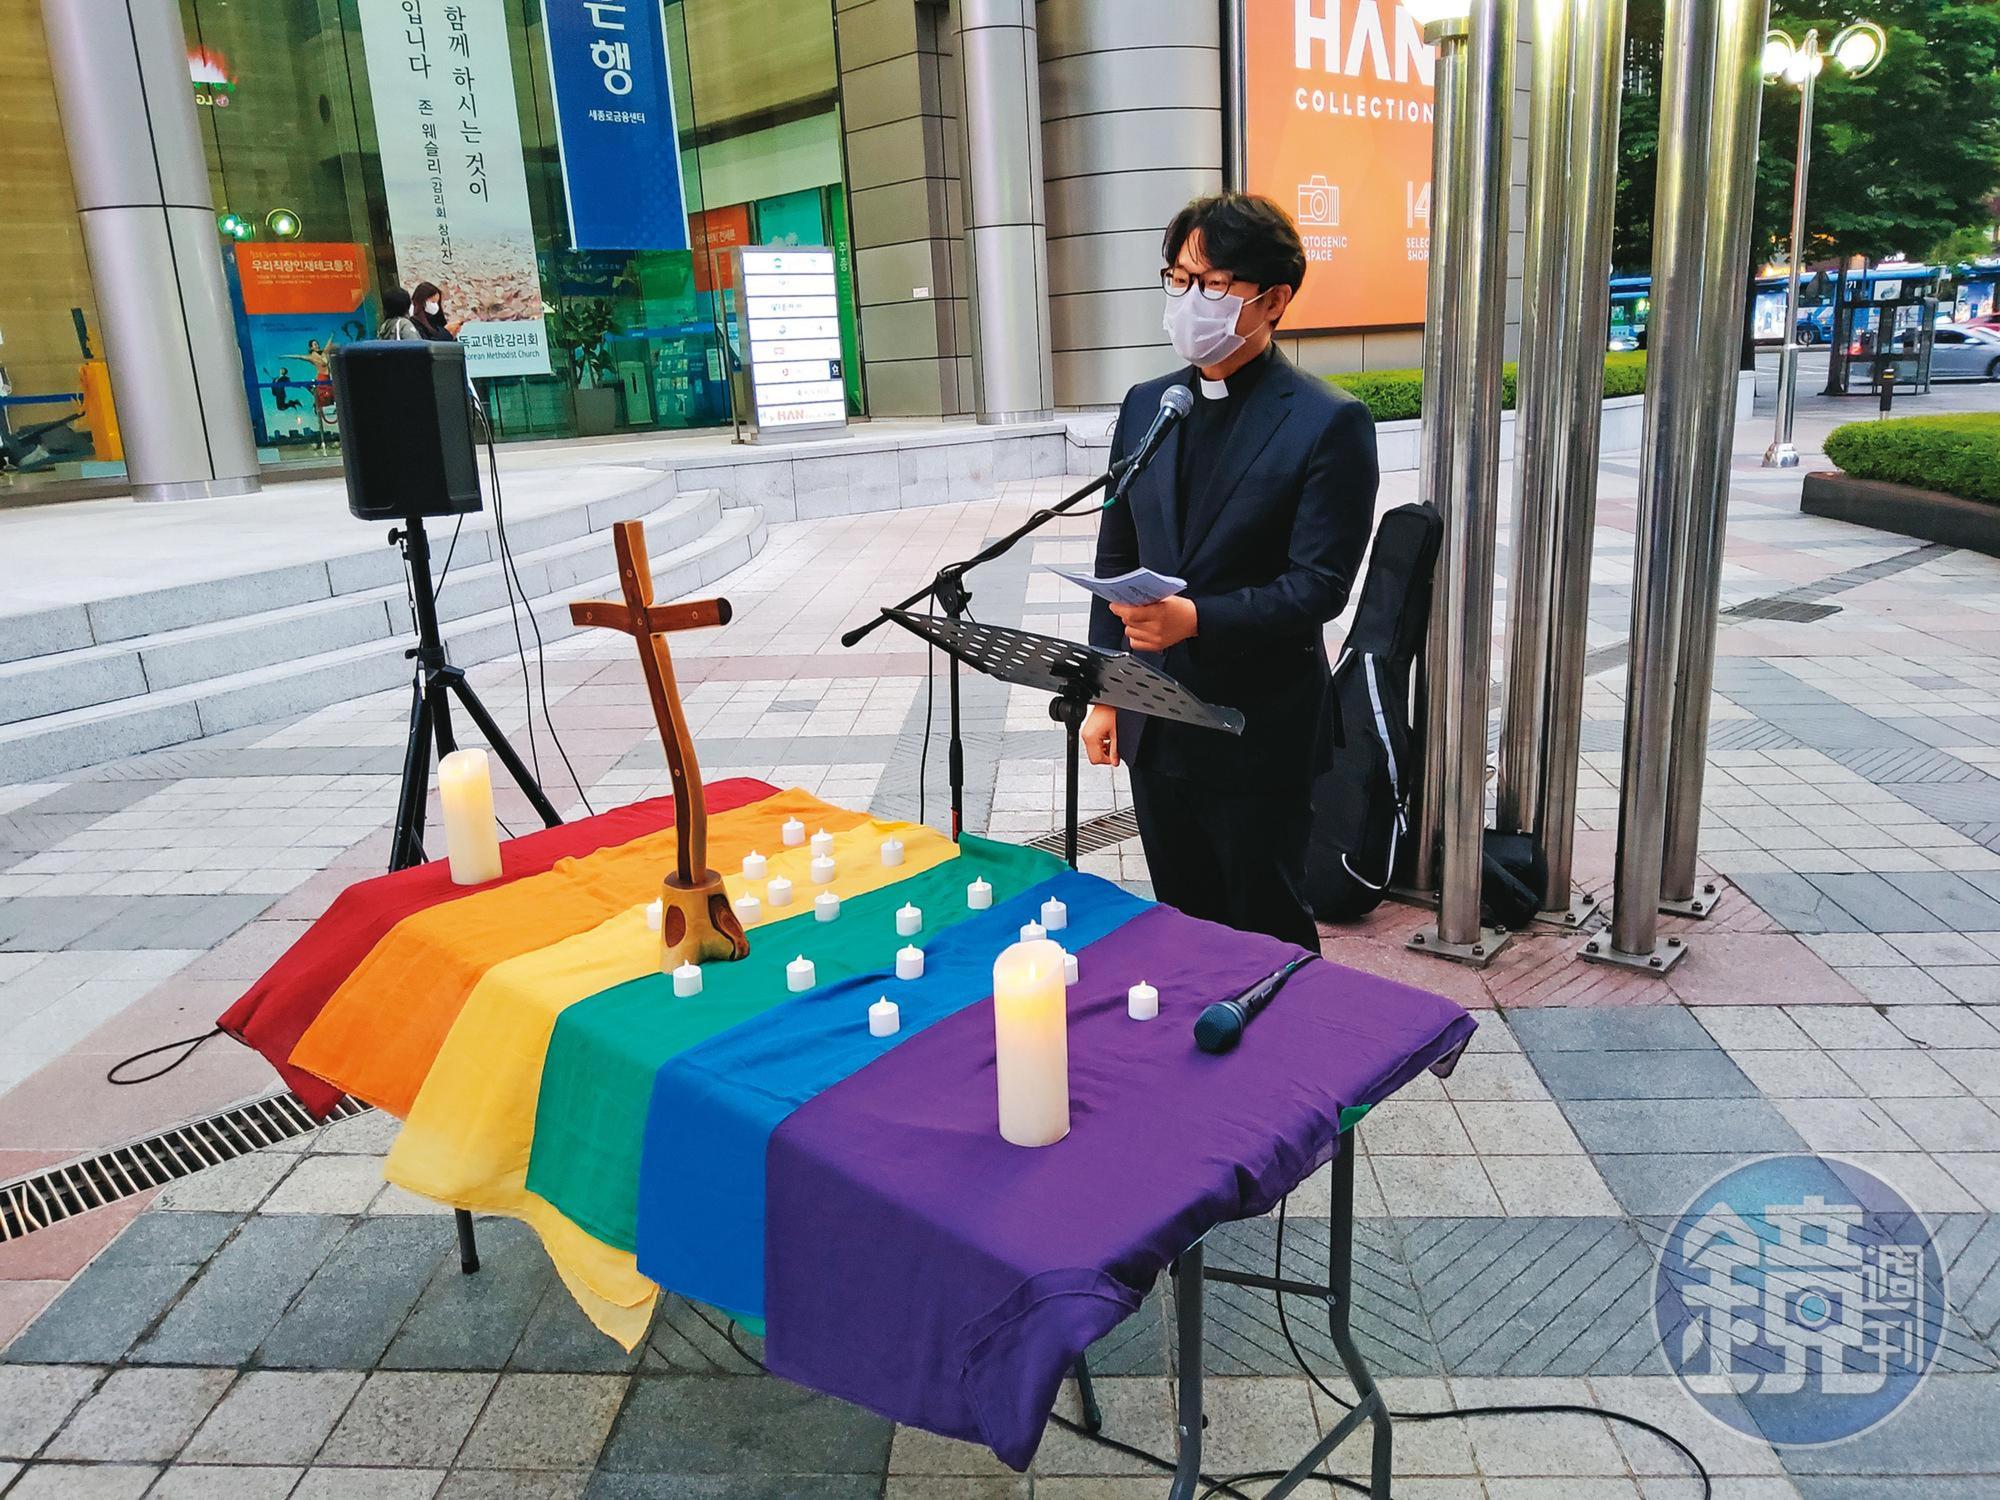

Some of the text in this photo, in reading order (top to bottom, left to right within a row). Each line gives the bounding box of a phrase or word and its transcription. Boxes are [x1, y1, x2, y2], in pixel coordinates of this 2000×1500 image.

[401, 0, 431, 79] 입니다
[1295, 0, 1436, 87] HAN
[418, 99, 434, 116] 존
[443, 6, 488, 203] 함께 하시는 것이
[1295, 87, 1434, 124] COLLECTION
[588, 109, 646, 124] 세종로금융센터
[1302, 236, 1348, 248] OTOGENIC
[1406, 237, 1430, 249] SELEC
[1306, 249, 1332, 261] SPACE
[466, 349, 540, 361] orean Methodist Church
